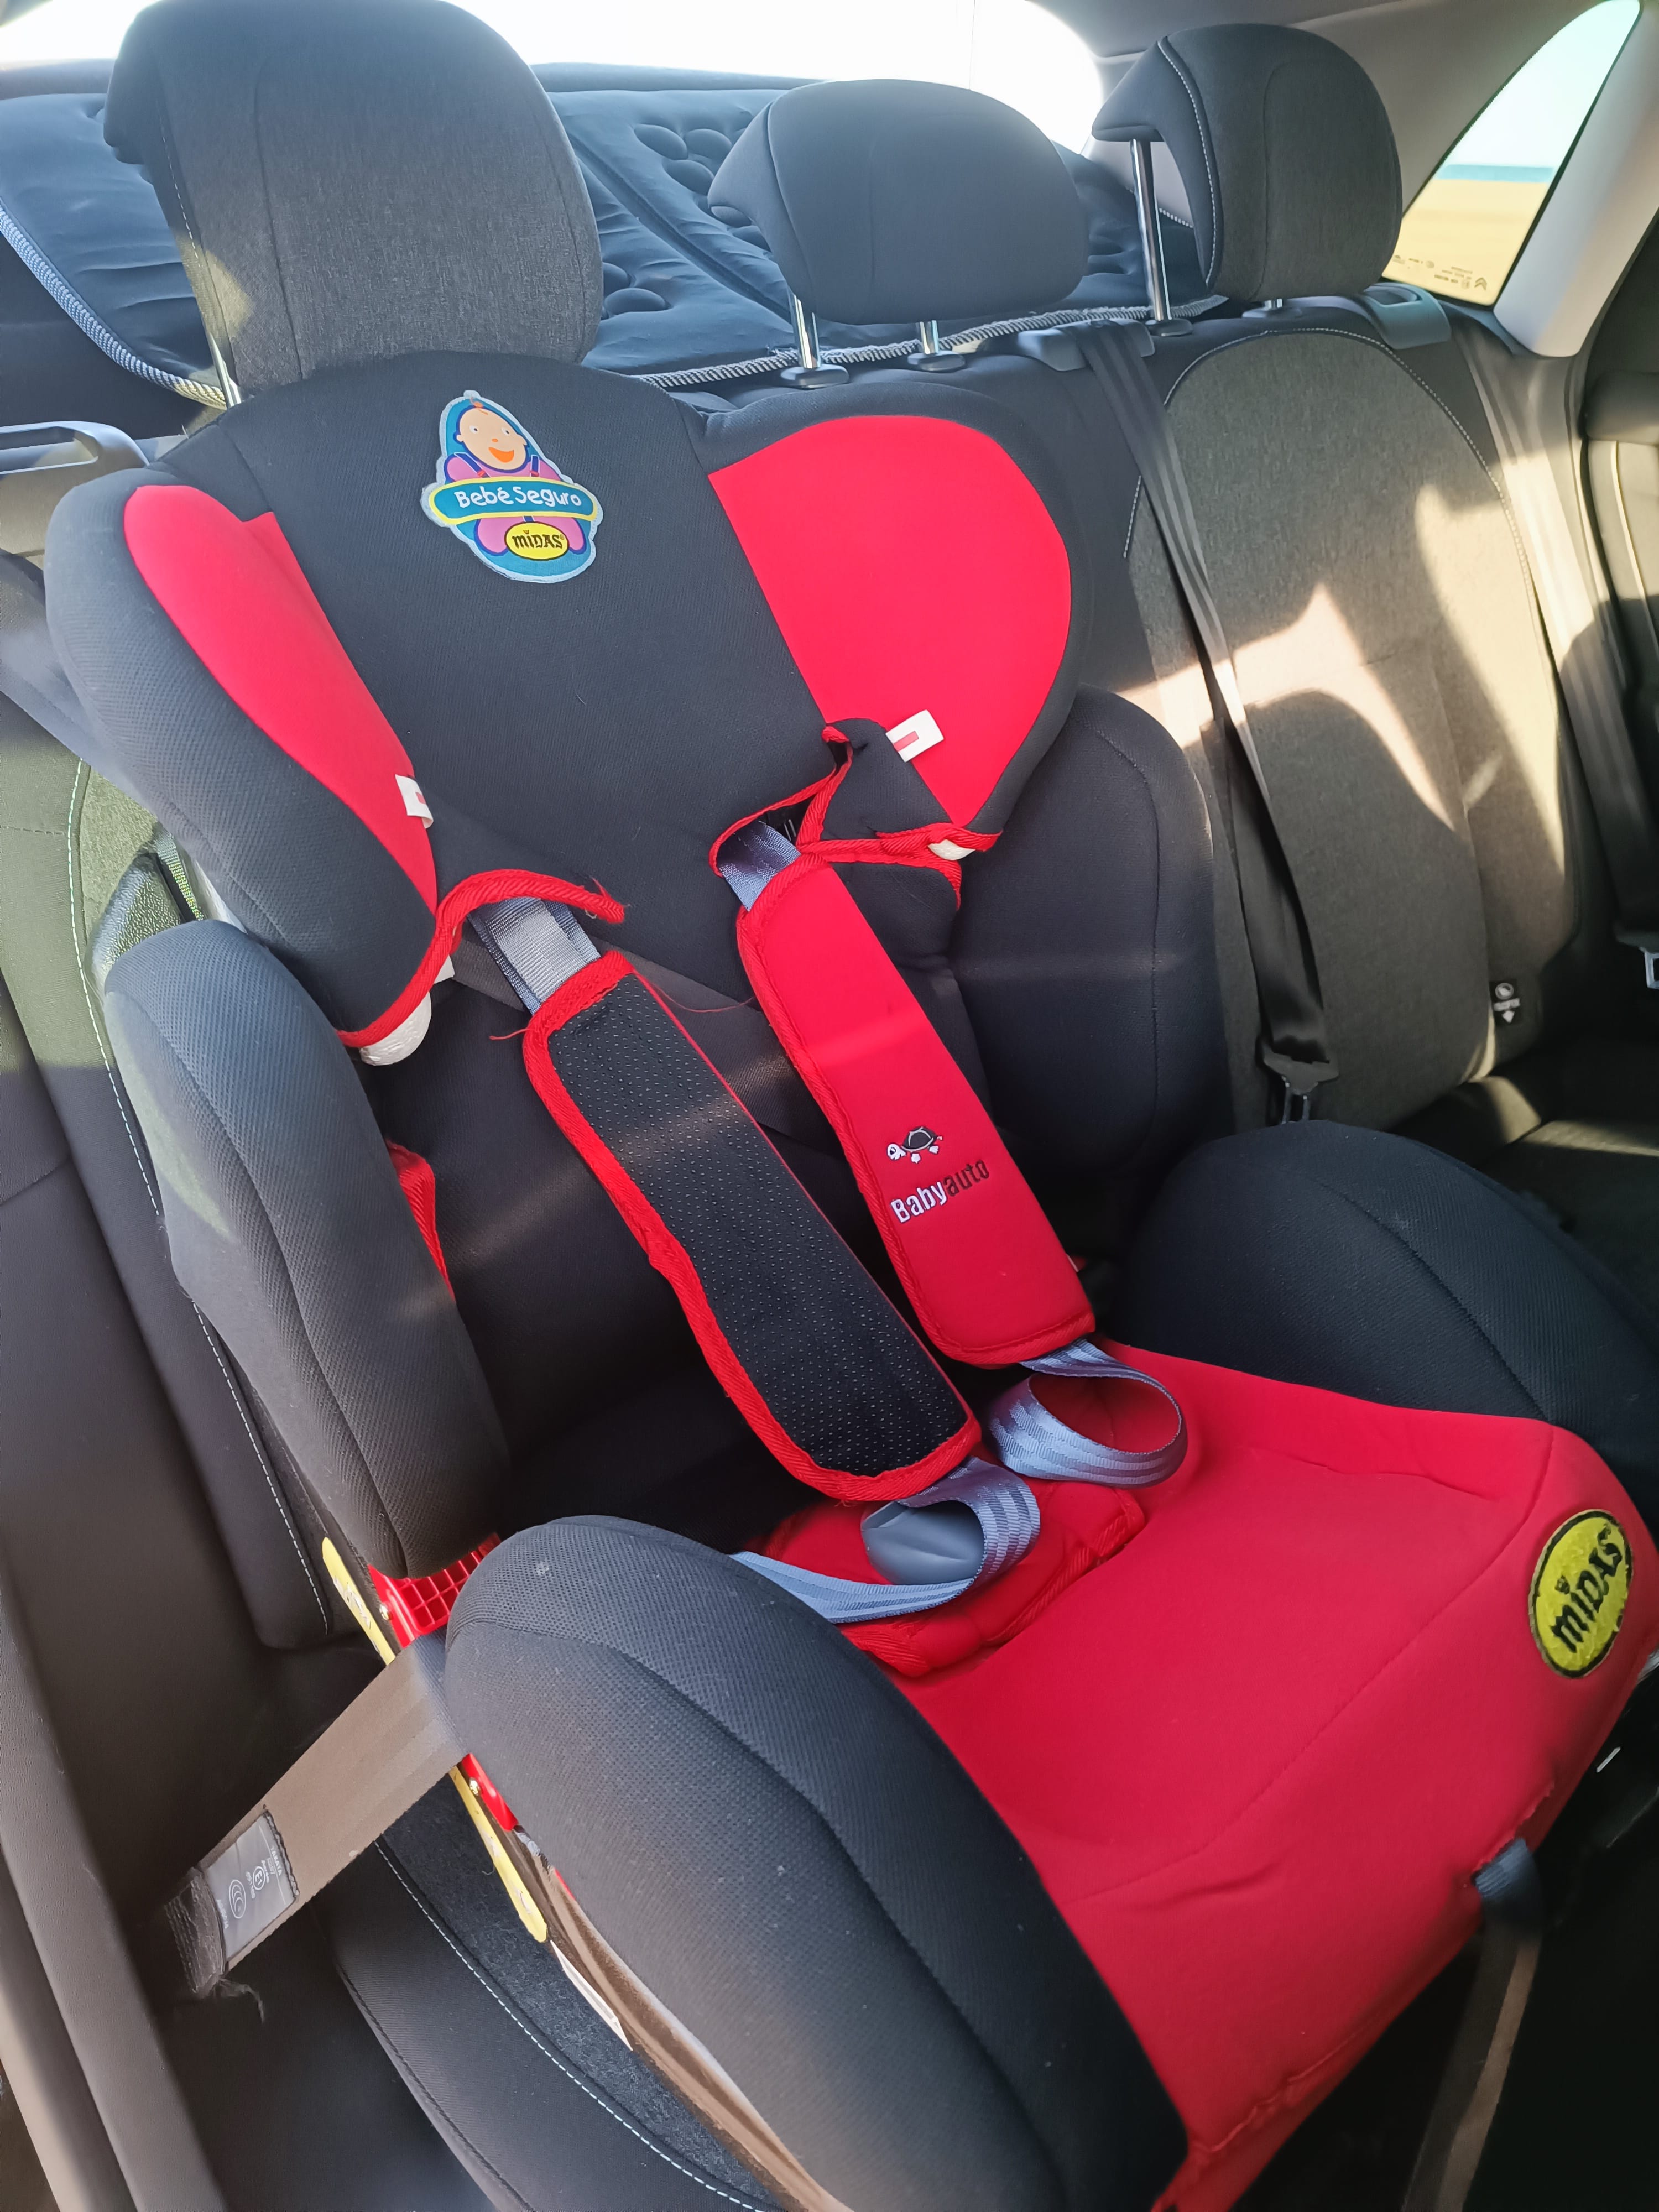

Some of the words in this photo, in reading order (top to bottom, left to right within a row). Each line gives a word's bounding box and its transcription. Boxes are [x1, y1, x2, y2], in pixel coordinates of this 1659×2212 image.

[454, 486, 509, 508] Bebé
[514, 486, 582, 507] Seguro
[890, 1159, 990, 1223] Babyauto
